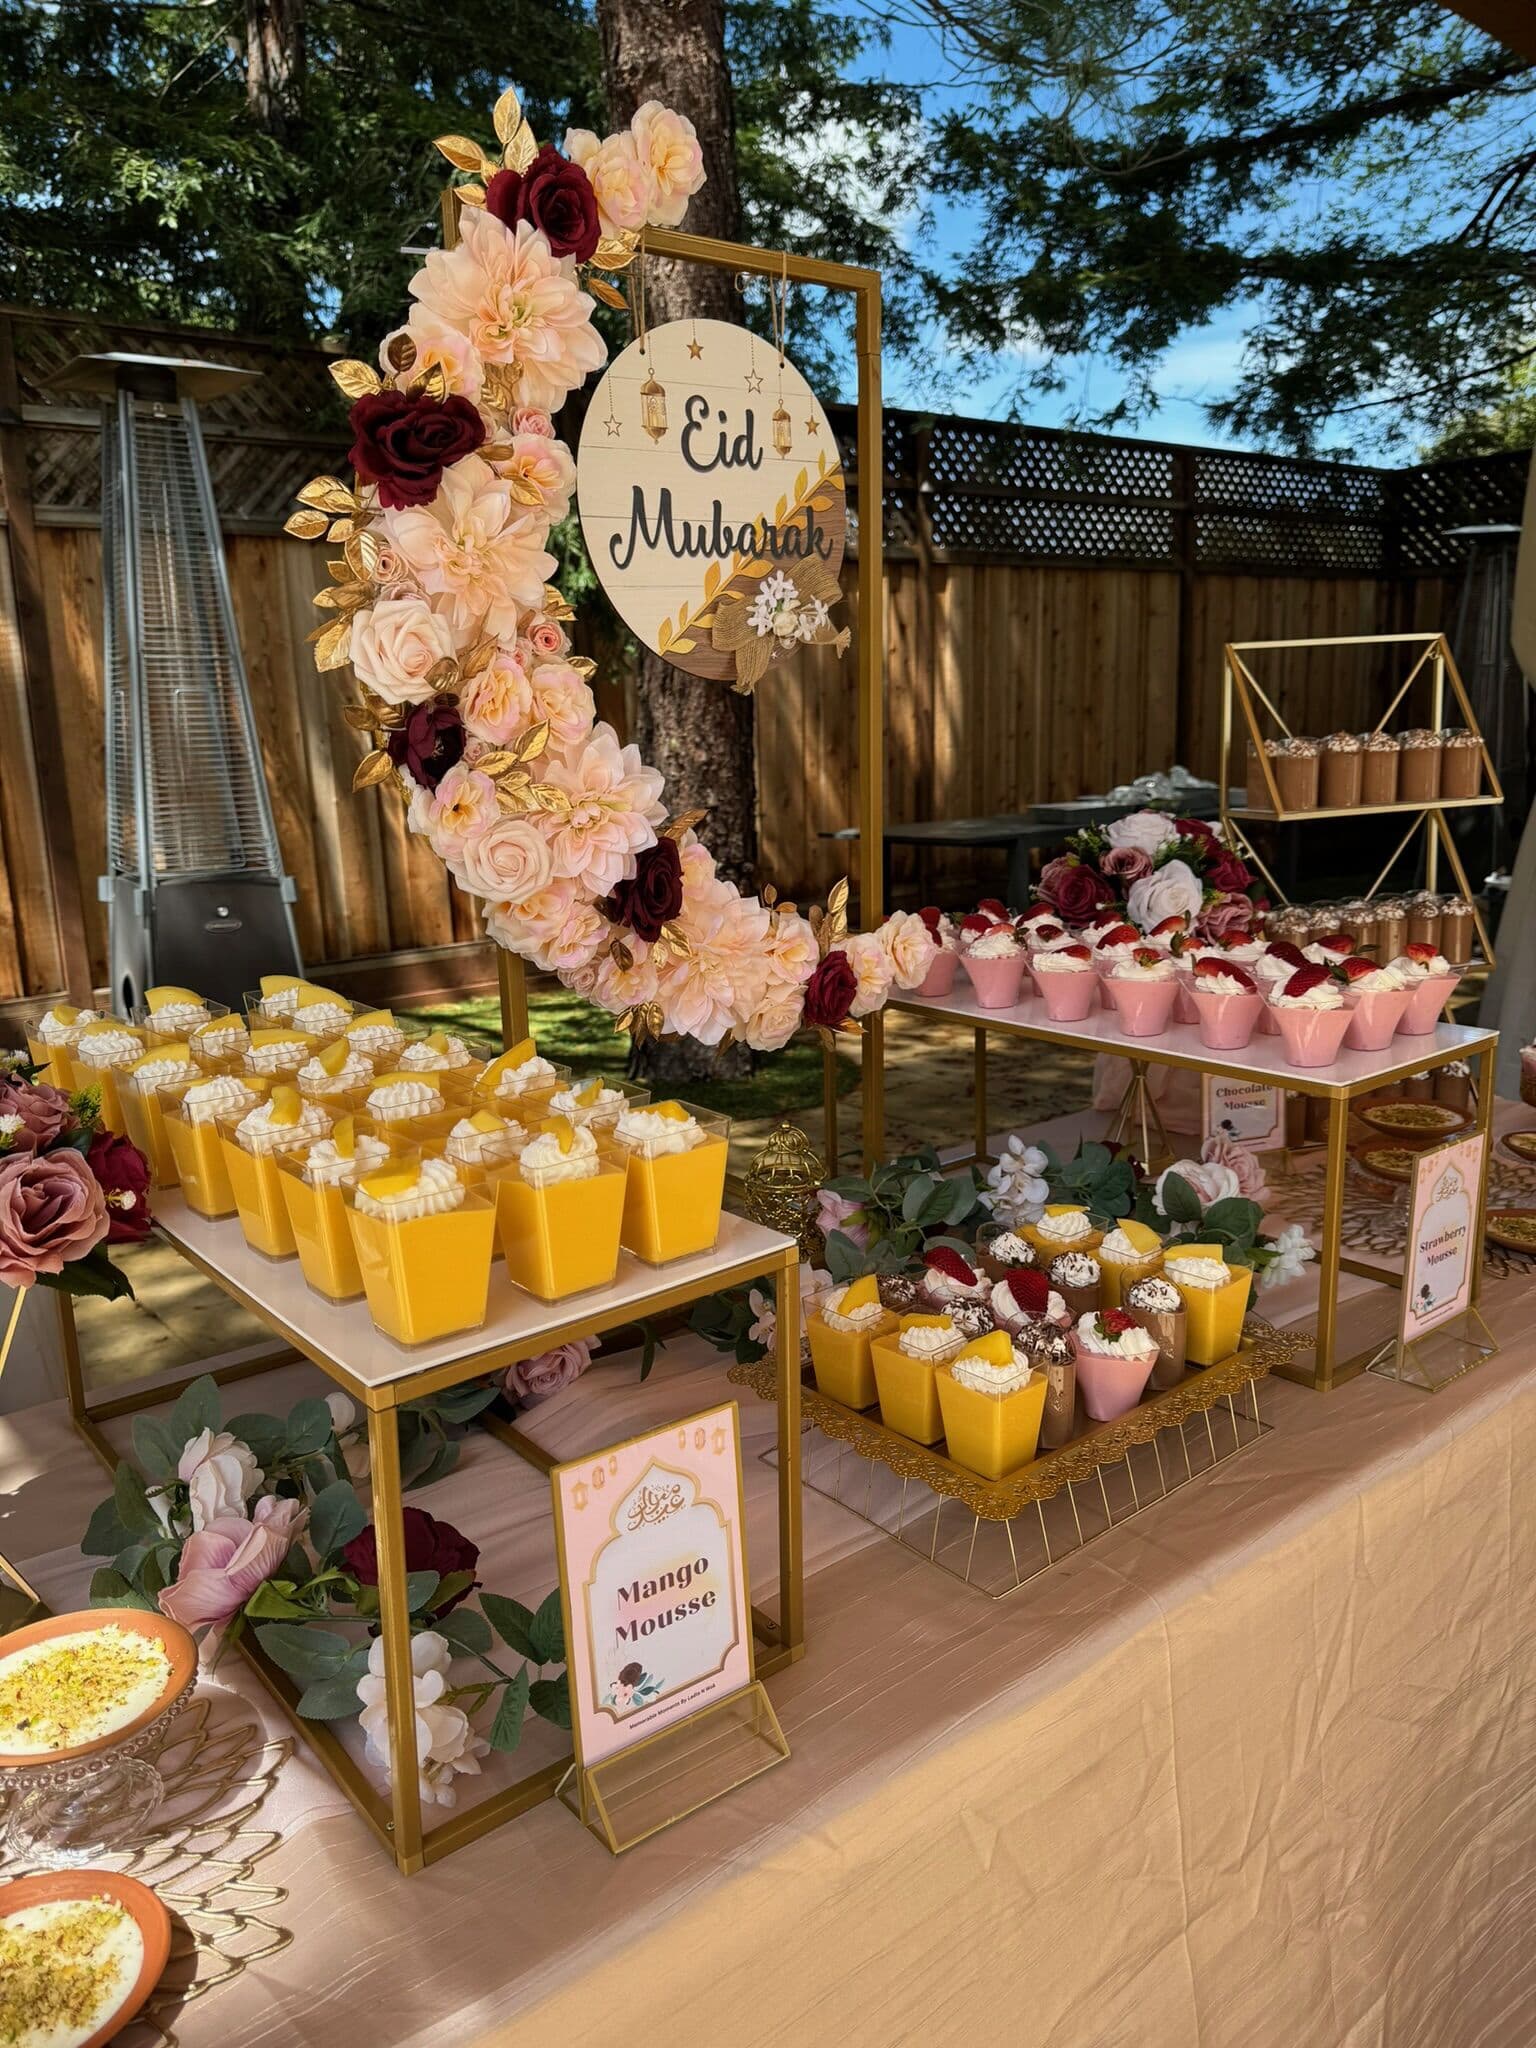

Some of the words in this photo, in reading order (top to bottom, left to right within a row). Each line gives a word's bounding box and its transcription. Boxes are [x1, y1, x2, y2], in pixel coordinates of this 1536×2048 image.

[681, 394, 763, 472] Eid
[609, 485, 833, 570] Mubarak
[1419, 1226, 1466, 1253] Strawberry
[1427, 1247, 1457, 1265] Mousse
[617, 1557, 709, 1611] Mango
[615, 1591, 716, 1648] Mousse
